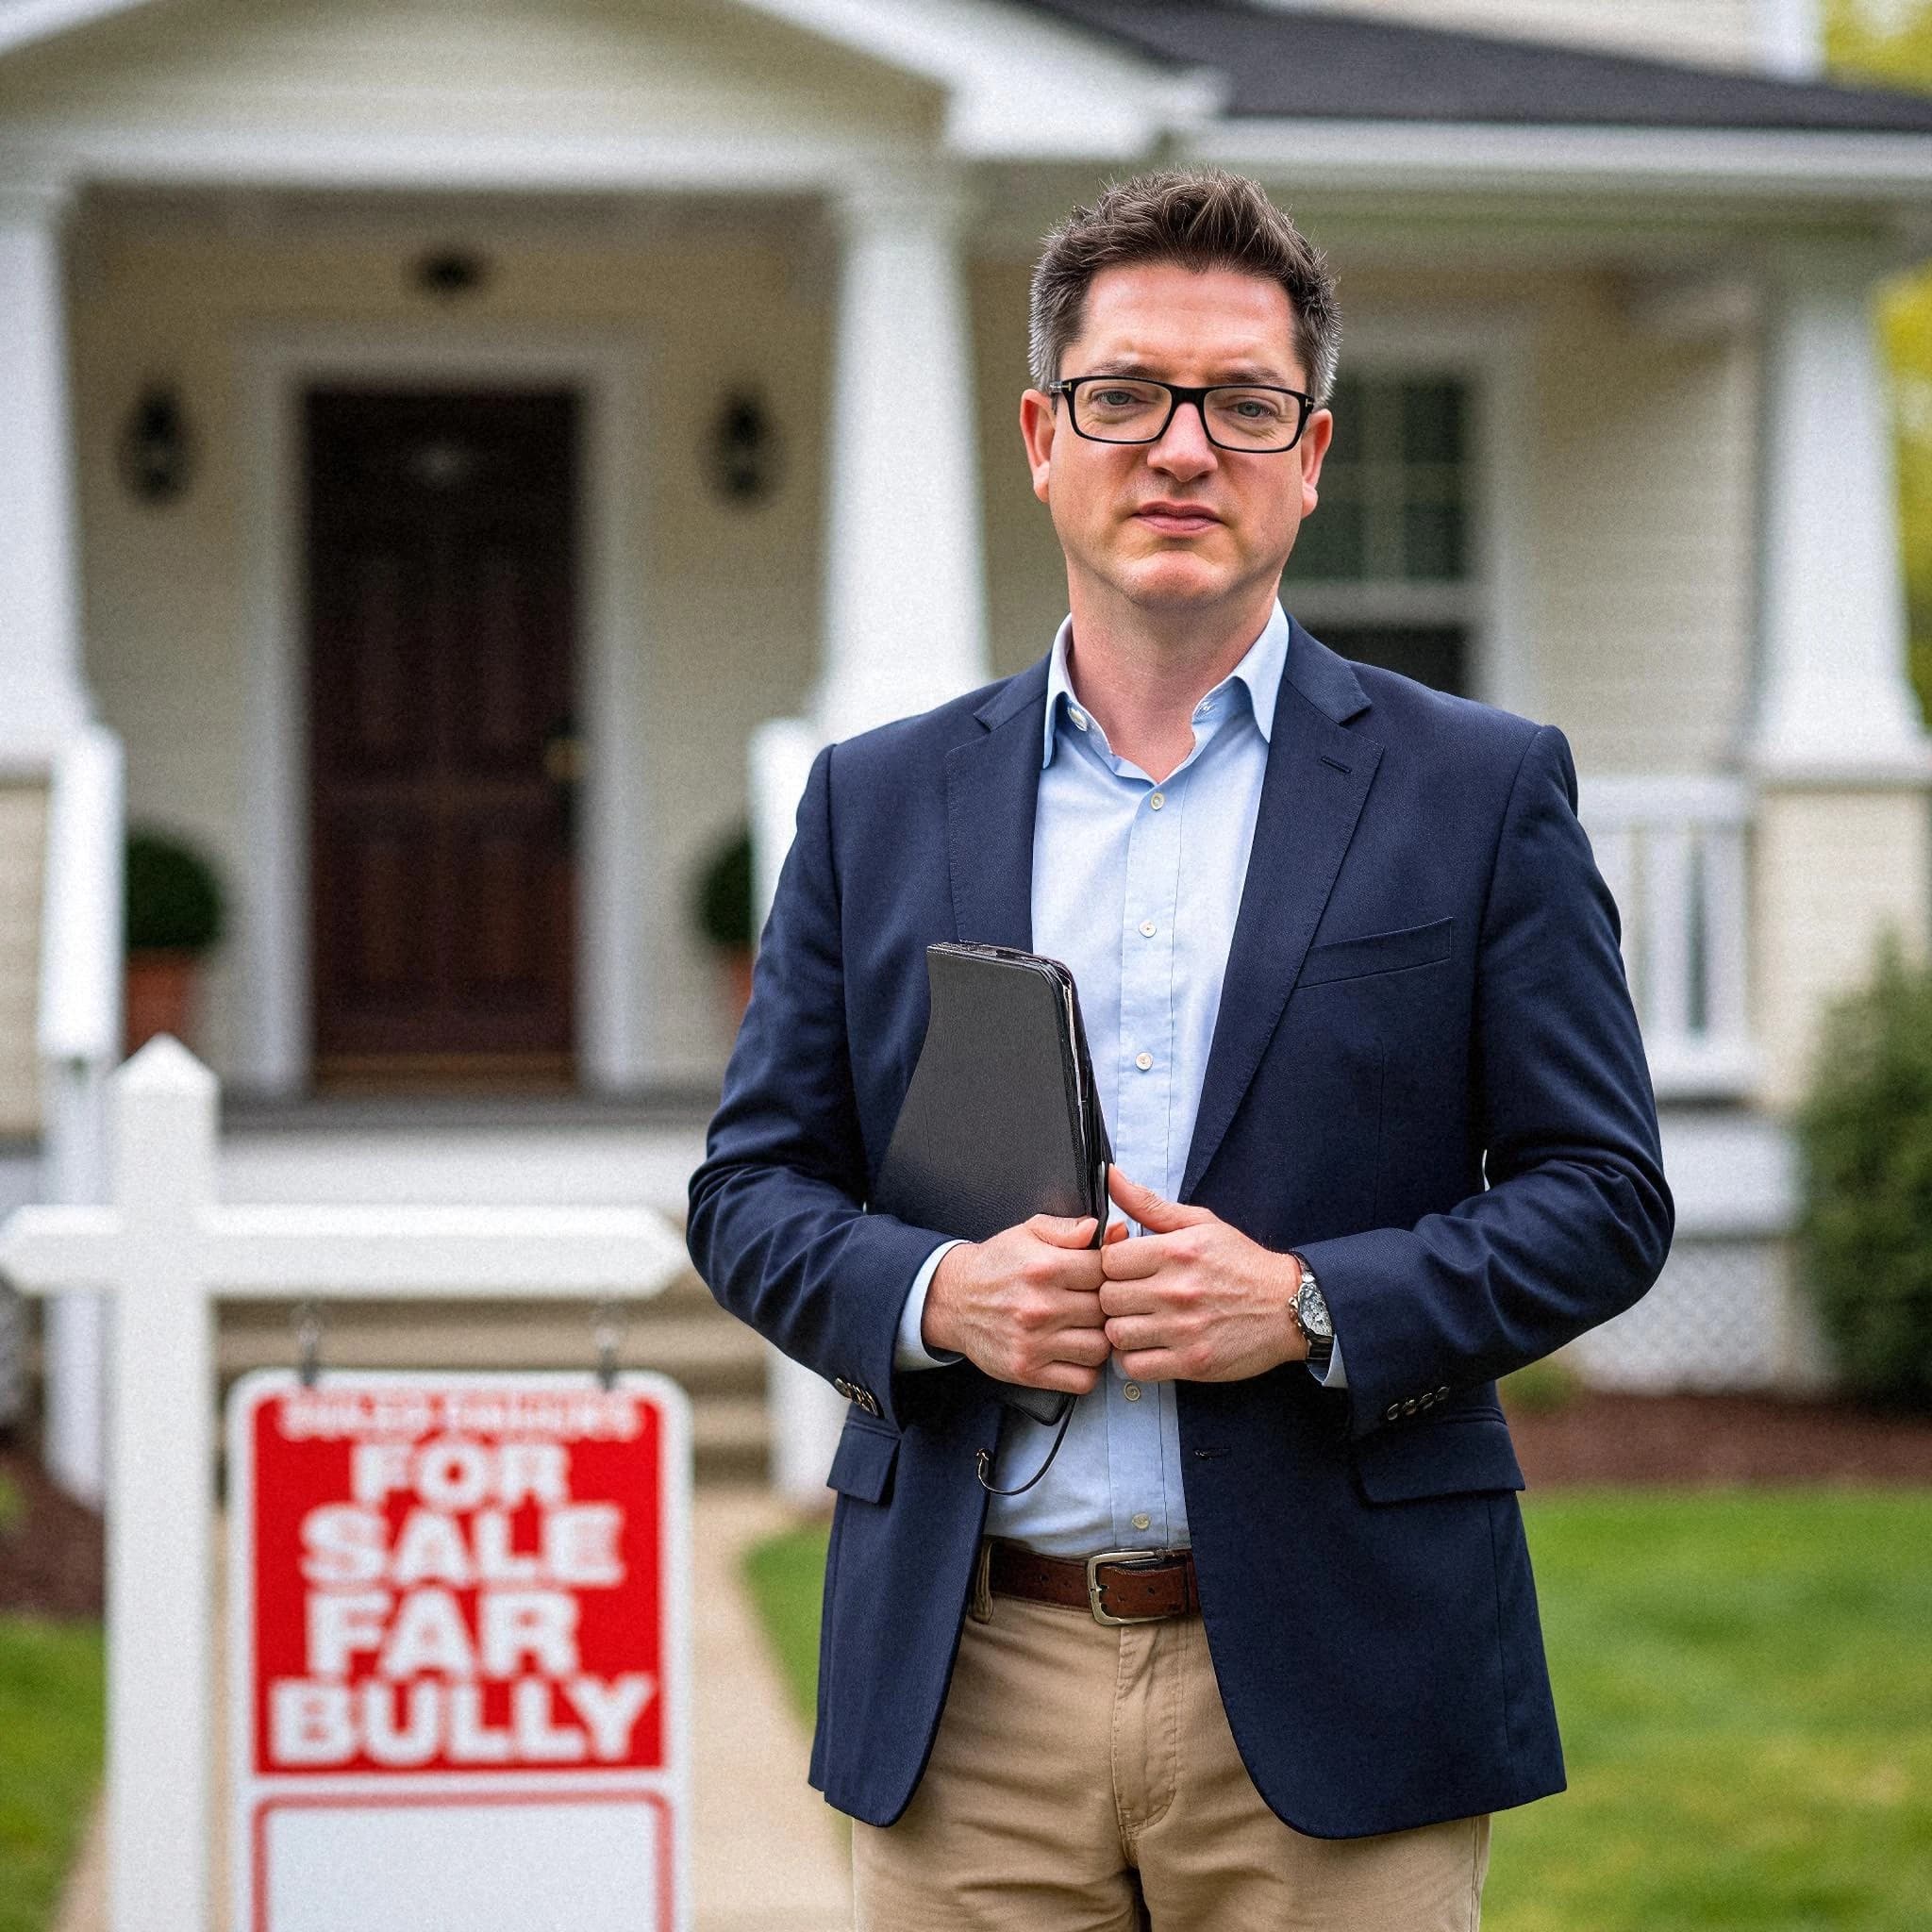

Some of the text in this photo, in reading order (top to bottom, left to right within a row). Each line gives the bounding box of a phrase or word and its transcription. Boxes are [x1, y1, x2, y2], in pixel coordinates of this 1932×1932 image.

[352, 1440, 569, 1507] FOR
[301, 1505, 622, 1587] SALE
[307, 1589, 580, 1678] FAR
[270, 1674, 653, 1762] BULLY
